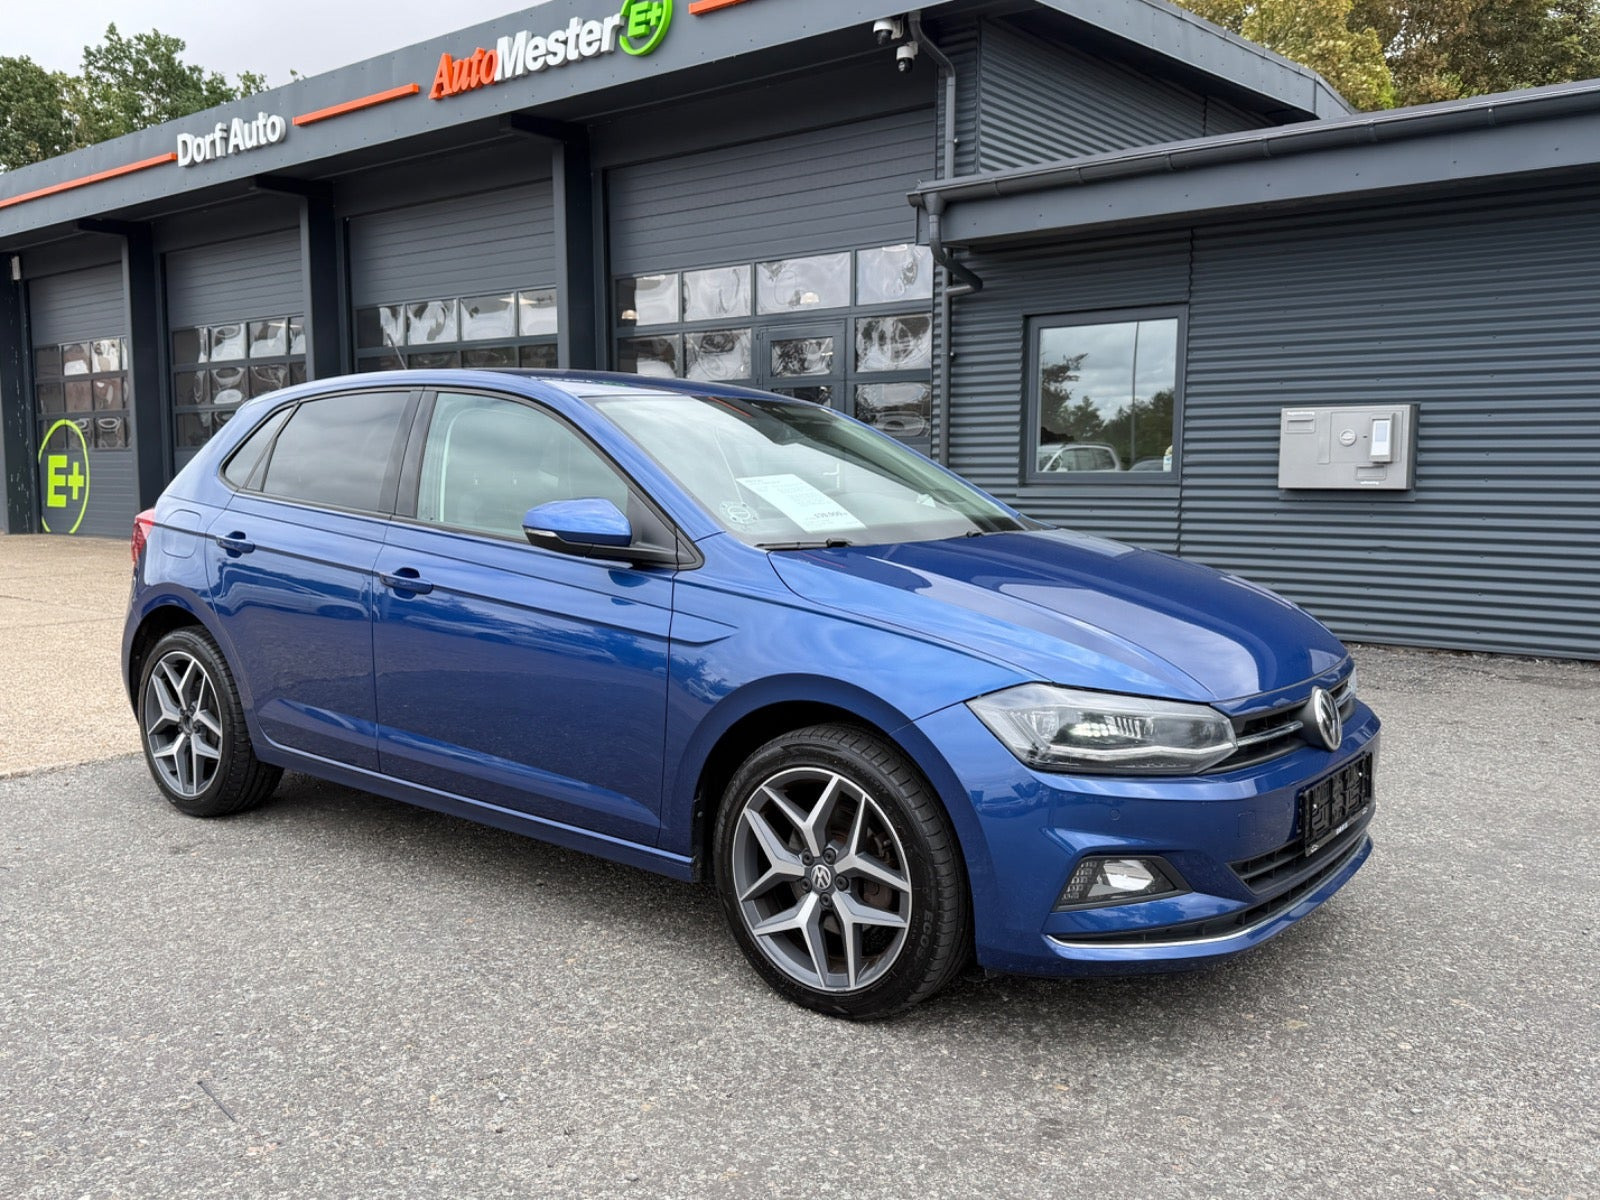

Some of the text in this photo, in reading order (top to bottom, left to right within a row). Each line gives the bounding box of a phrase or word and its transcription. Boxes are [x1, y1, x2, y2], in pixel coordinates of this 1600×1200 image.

[428, 1, 663, 100] AutoMester E+
[177, 111, 286, 167] Dorf Auto
[47, 455, 84, 507] E+
